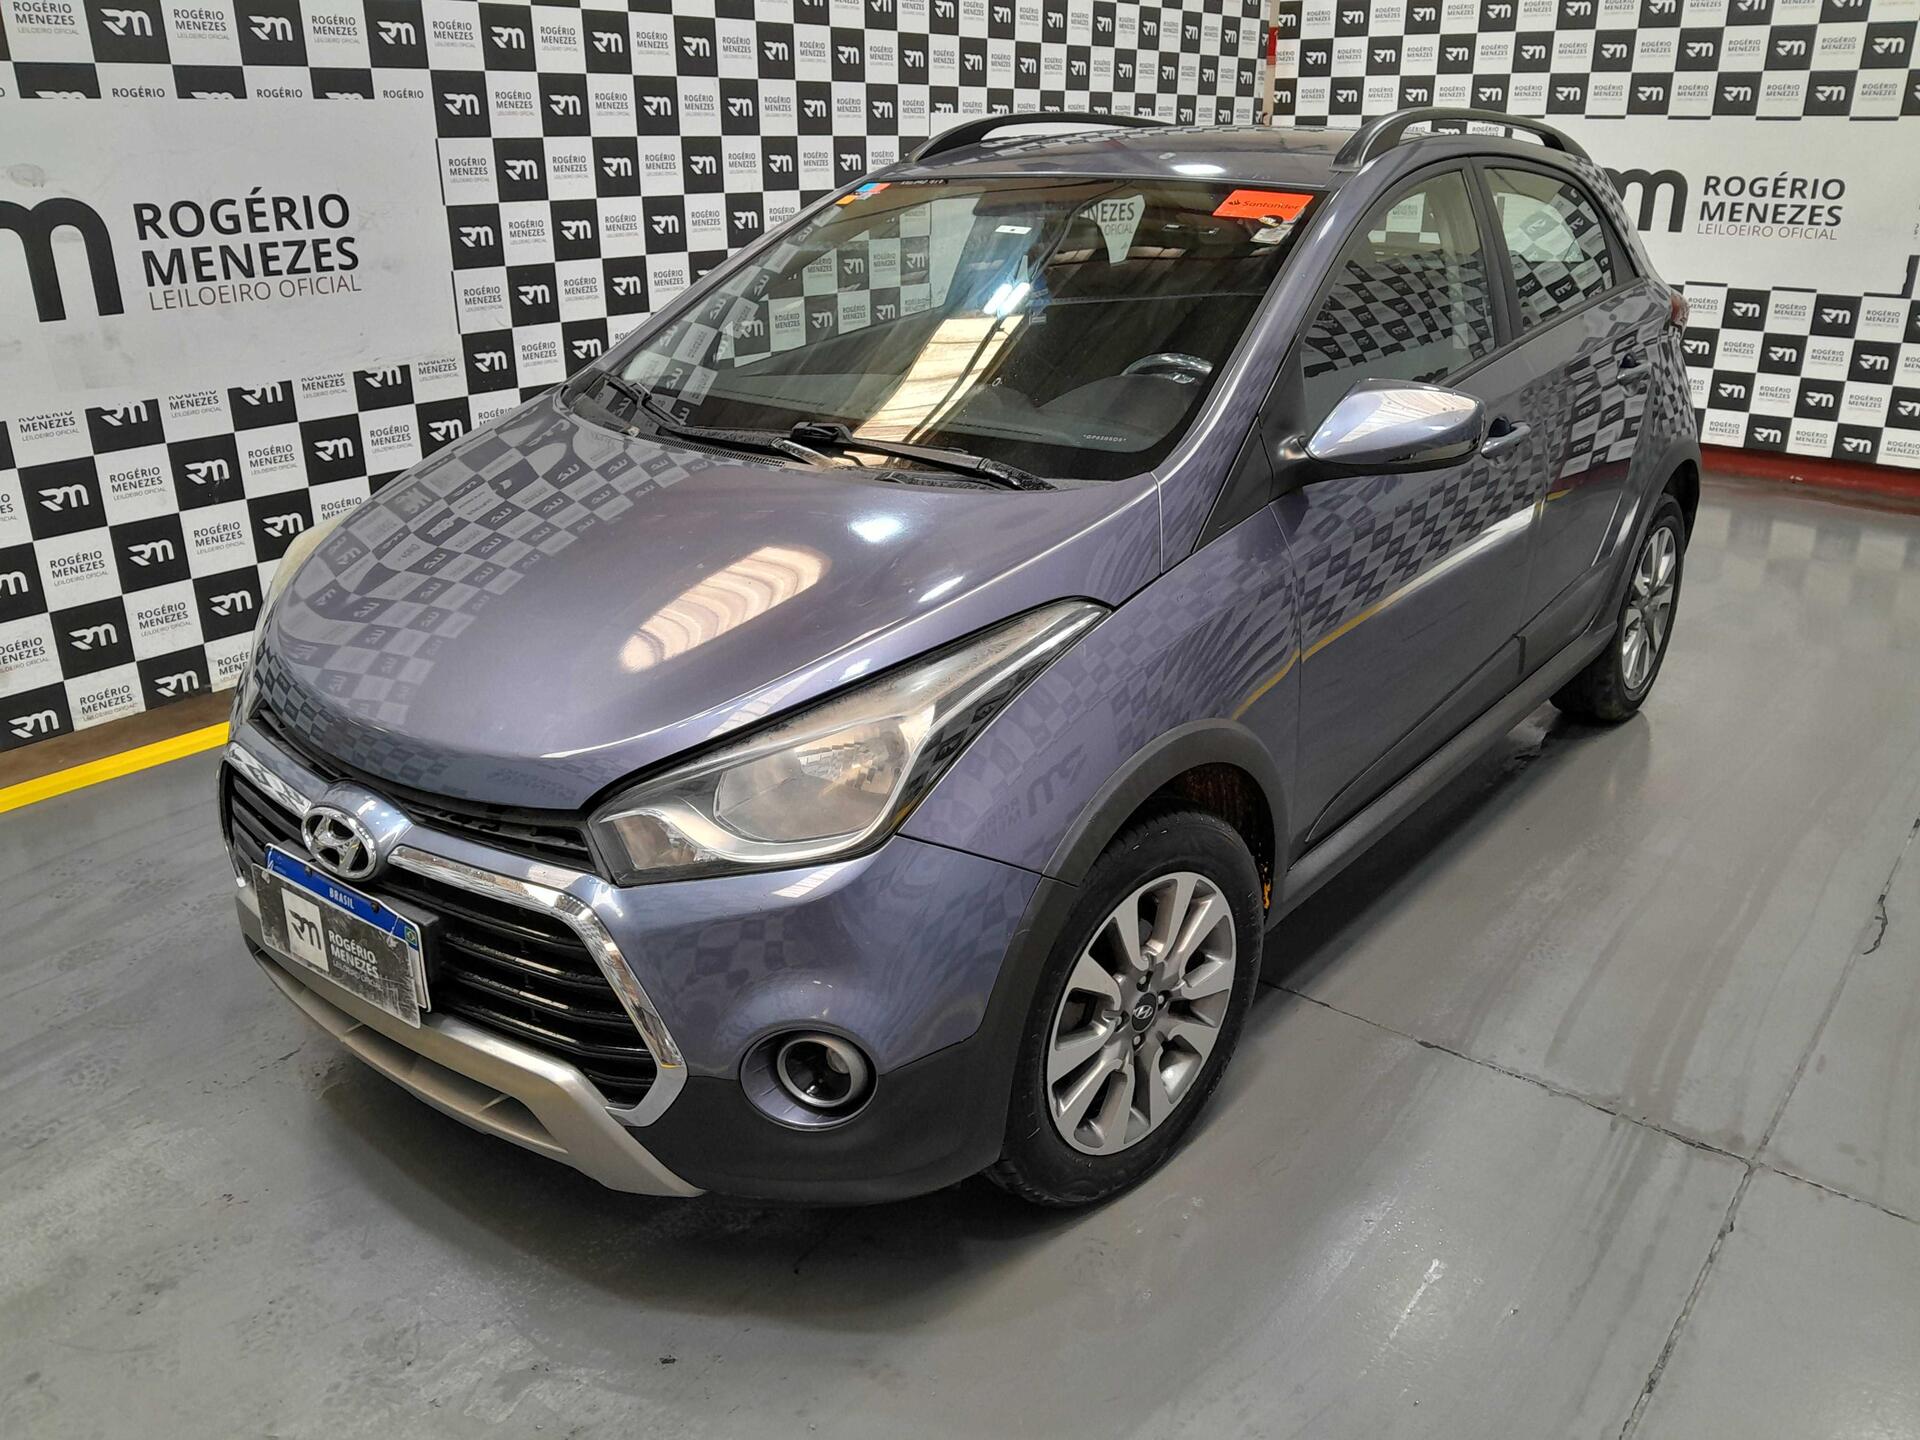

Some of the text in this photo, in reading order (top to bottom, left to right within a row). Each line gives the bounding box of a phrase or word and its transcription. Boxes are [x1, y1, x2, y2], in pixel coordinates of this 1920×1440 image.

[13, 0, 72, 14] ROGÉRIO
[173, 8, 224, 21] ROGÉRIO
[15, 14, 75, 26] MENEZES
[311, 14, 356, 26] ROGÉRIO
[175, 21, 227, 32] MENEZES
[432, 20, 472, 31] ROGÉRIO
[540, 25, 576, 35] ROGÉRIO
[313, 26, 358, 36] MENEZES
[434, 30, 474, 41] MENEZES
[636, 31, 668, 40] ROGÉRIO
[541, 36, 577, 44] MENEZES
[637, 40, 669, 49] MENEZES
[722, 35, 751, 46] ROGÉRIO
[799, 39, 825, 50] ROGÉRIO
[1641, 40, 1671, 48] ROGÉRIO
[1729, 38, 1761, 47] ROGÉRIO
[1823, 36, 1856, 45] ROGÉRIO
[722, 44, 751, 53] MENEZES
[869, 44, 893, 54] ROGÉRIO
[1728, 45, 1760, 53] MENEZES
[1821, 43, 1856, 51] MENEZES
[800, 49, 826, 58] MENEZES
[870, 52, 894, 61] MENEZES
[933, 48, 955, 57] ROGÉRIO
[933, 56, 955, 65] MENEZES
[112, 86, 166, 98] ROGÉRIO
[1766, 83, 1800, 91] ROGÉRIO
[1863, 83, 1897, 91] ROGÉRIO
[257, 87, 303, 98] ROGÉRIO
[383, 89, 424, 99] ROGÉRIO
[495, 90, 531, 100] ROGÉRIO
[595, 91, 628, 101] ROGÉRIO
[1861, 89, 1897, 97] MENEZES
[684, 93, 713, 103] ROGÉRIO
[764, 95, 791, 105] ROGÉRIO
[837, 97, 861, 106] ROGÉRIO
[902, 99, 925, 107] ROGÉRIO
[496, 100, 533, 109] MENEZES
[595, 101, 628, 110] MENEZES
[685, 102, 714, 111] MENEZES
[764, 104, 791, 112] MENEZES
[837, 105, 861, 114] MENEZES
[902, 106, 925, 114] MENEZES
[552, 154, 586, 164] ROGÉRIO
[645, 153, 675, 162] ROGÉRIO
[728, 151, 756, 161] ROGÉRIO
[803, 150, 828, 160] ROGÉRIO
[449, 156, 487, 167] ROGÉRIO
[645, 162, 676, 171] MENEZES
[729, 159, 756, 168] MENEZES
[803, 158, 828, 167] MENEZES
[449, 166, 488, 176] MENEZES
[553, 164, 587, 173] MENEZES
[1703, 172, 1845, 200] ROGÉRIO
[1242, 200, 1300, 210] Santander
[134, 186, 350, 240] ROGÉRIO
[691, 208, 720, 219] ROGÉRIO
[1087, 202, 1135, 222] NEZES
[1700, 201, 1843, 227] MENEZES
[605, 213, 636, 223] ROGÉRIO
[691, 217, 720, 227] MENEZES
[508, 218, 544, 229] ROGÉRIO
[605, 222, 638, 232] MENEZES
[509, 228, 545, 238] MENEZES
[1105, 224, 1134, 236] OFICIAL
[1697, 223, 1837, 241] LEILOEIRO OFICIAL
[142, 236, 359, 286] MENEZES
[653, 268, 683, 279] ROGÉRIO
[563, 276, 596, 287] ROGÉRIO
[654, 277, 684, 287] MENEZES
[150, 274, 362, 310] LEILOEIRO OFICIAL
[464, 285, 500, 296] ROGÉRIO
[564, 286, 598, 296] MENEZES
[465, 295, 502, 305] MENEZES
[1775, 302, 1807, 311] ROGÉRIO
[1774, 309, 1806, 317] MENEZES
[1866, 308, 1900, 318] ROGÉRIO
[1865, 315, 1899, 324] MENEZES
[522, 341, 556, 351] ROGÉRIO
[1723, 340, 1755, 349] ROGÉRIO
[522, 350, 557, 360] MENEZES
[1722, 346, 1754, 355] MENEZES
[1812, 347, 1844, 356] ROGÉRIO
[1811, 354, 1843, 362] MENEZES
[418, 363, 457, 375] MENEZES
[302, 378, 345, 391] MENEZES
[1760, 384, 1791, 394] ROGÉRIO
[1759, 391, 1790, 400] MENEZES
[1849, 392, 1883, 403] ROGÉRIO
[170, 395, 219, 411] MENEZES
[1848, 400, 1882, 409] MENEZES
[20, 417, 76, 433] MENEZES
[1710, 420, 1740, 429] ROGÉRIO
[370, 425, 410, 438] ROGÉRIO
[1709, 426, 1739, 435] MENEZES
[1796, 429, 1828, 439] ROGÉRIO
[371, 433, 412, 447] MENEZES
[1795, 436, 1827, 445] MENEZES
[248, 444, 293, 459] ROGÉRIO
[250, 453, 295, 468] MENEZES
[110, 466, 161, 483] ROGÉRIO
[111, 476, 163, 493] MENEZES
[321, 497, 362, 511] ROGÉRIO
[193, 521, 240, 538] ROGÉRIO
[195, 530, 242, 547] MENEZES
[50, 550, 103, 568] ROGÉRIO
[52, 560, 105, 579] MENEZES
[137, 601, 186, 620] ROGÉRIO
[139, 611, 189, 630] MENEZES
[0, 637, 42, 655] OGÉRIO
[79, 685, 130, 705] ROGÉRIO
[81, 694, 133, 715] MENEZES
[329, 888, 354, 910] BRASIL
[328, 930, 377, 964] ROGÉRIO
[331, 944, 379, 979] MENEZES
